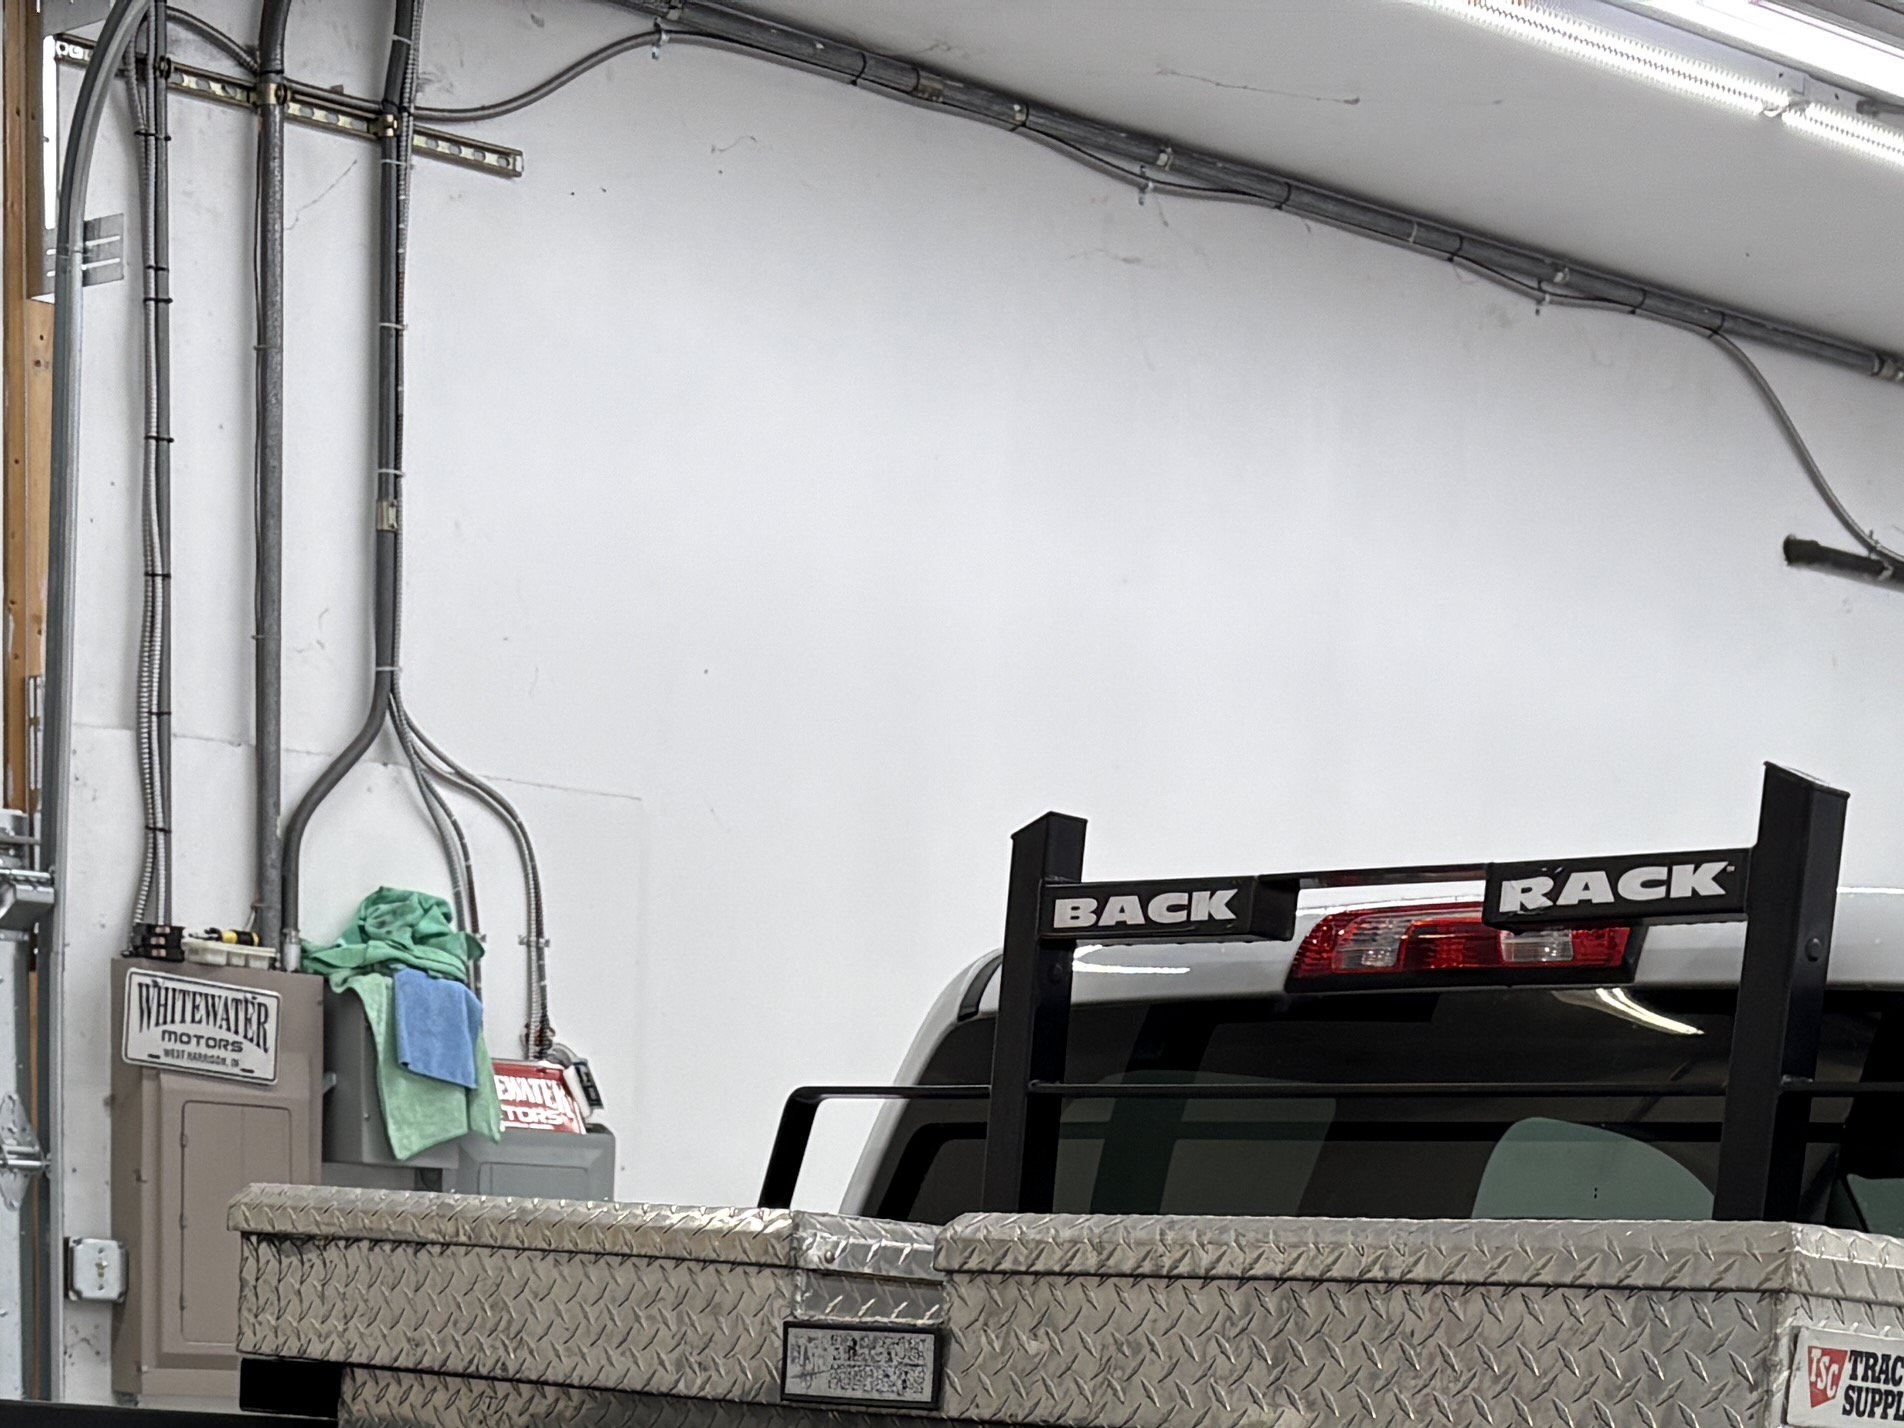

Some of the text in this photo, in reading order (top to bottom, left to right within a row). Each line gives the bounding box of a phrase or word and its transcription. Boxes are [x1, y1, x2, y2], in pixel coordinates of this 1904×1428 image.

[1053, 860, 1728, 929] BACK RACK
[137, 982, 270, 1054] WHITEWATER
[161, 1029, 244, 1053] MOTORS
[1809, 1349, 1839, 1399] TSC
